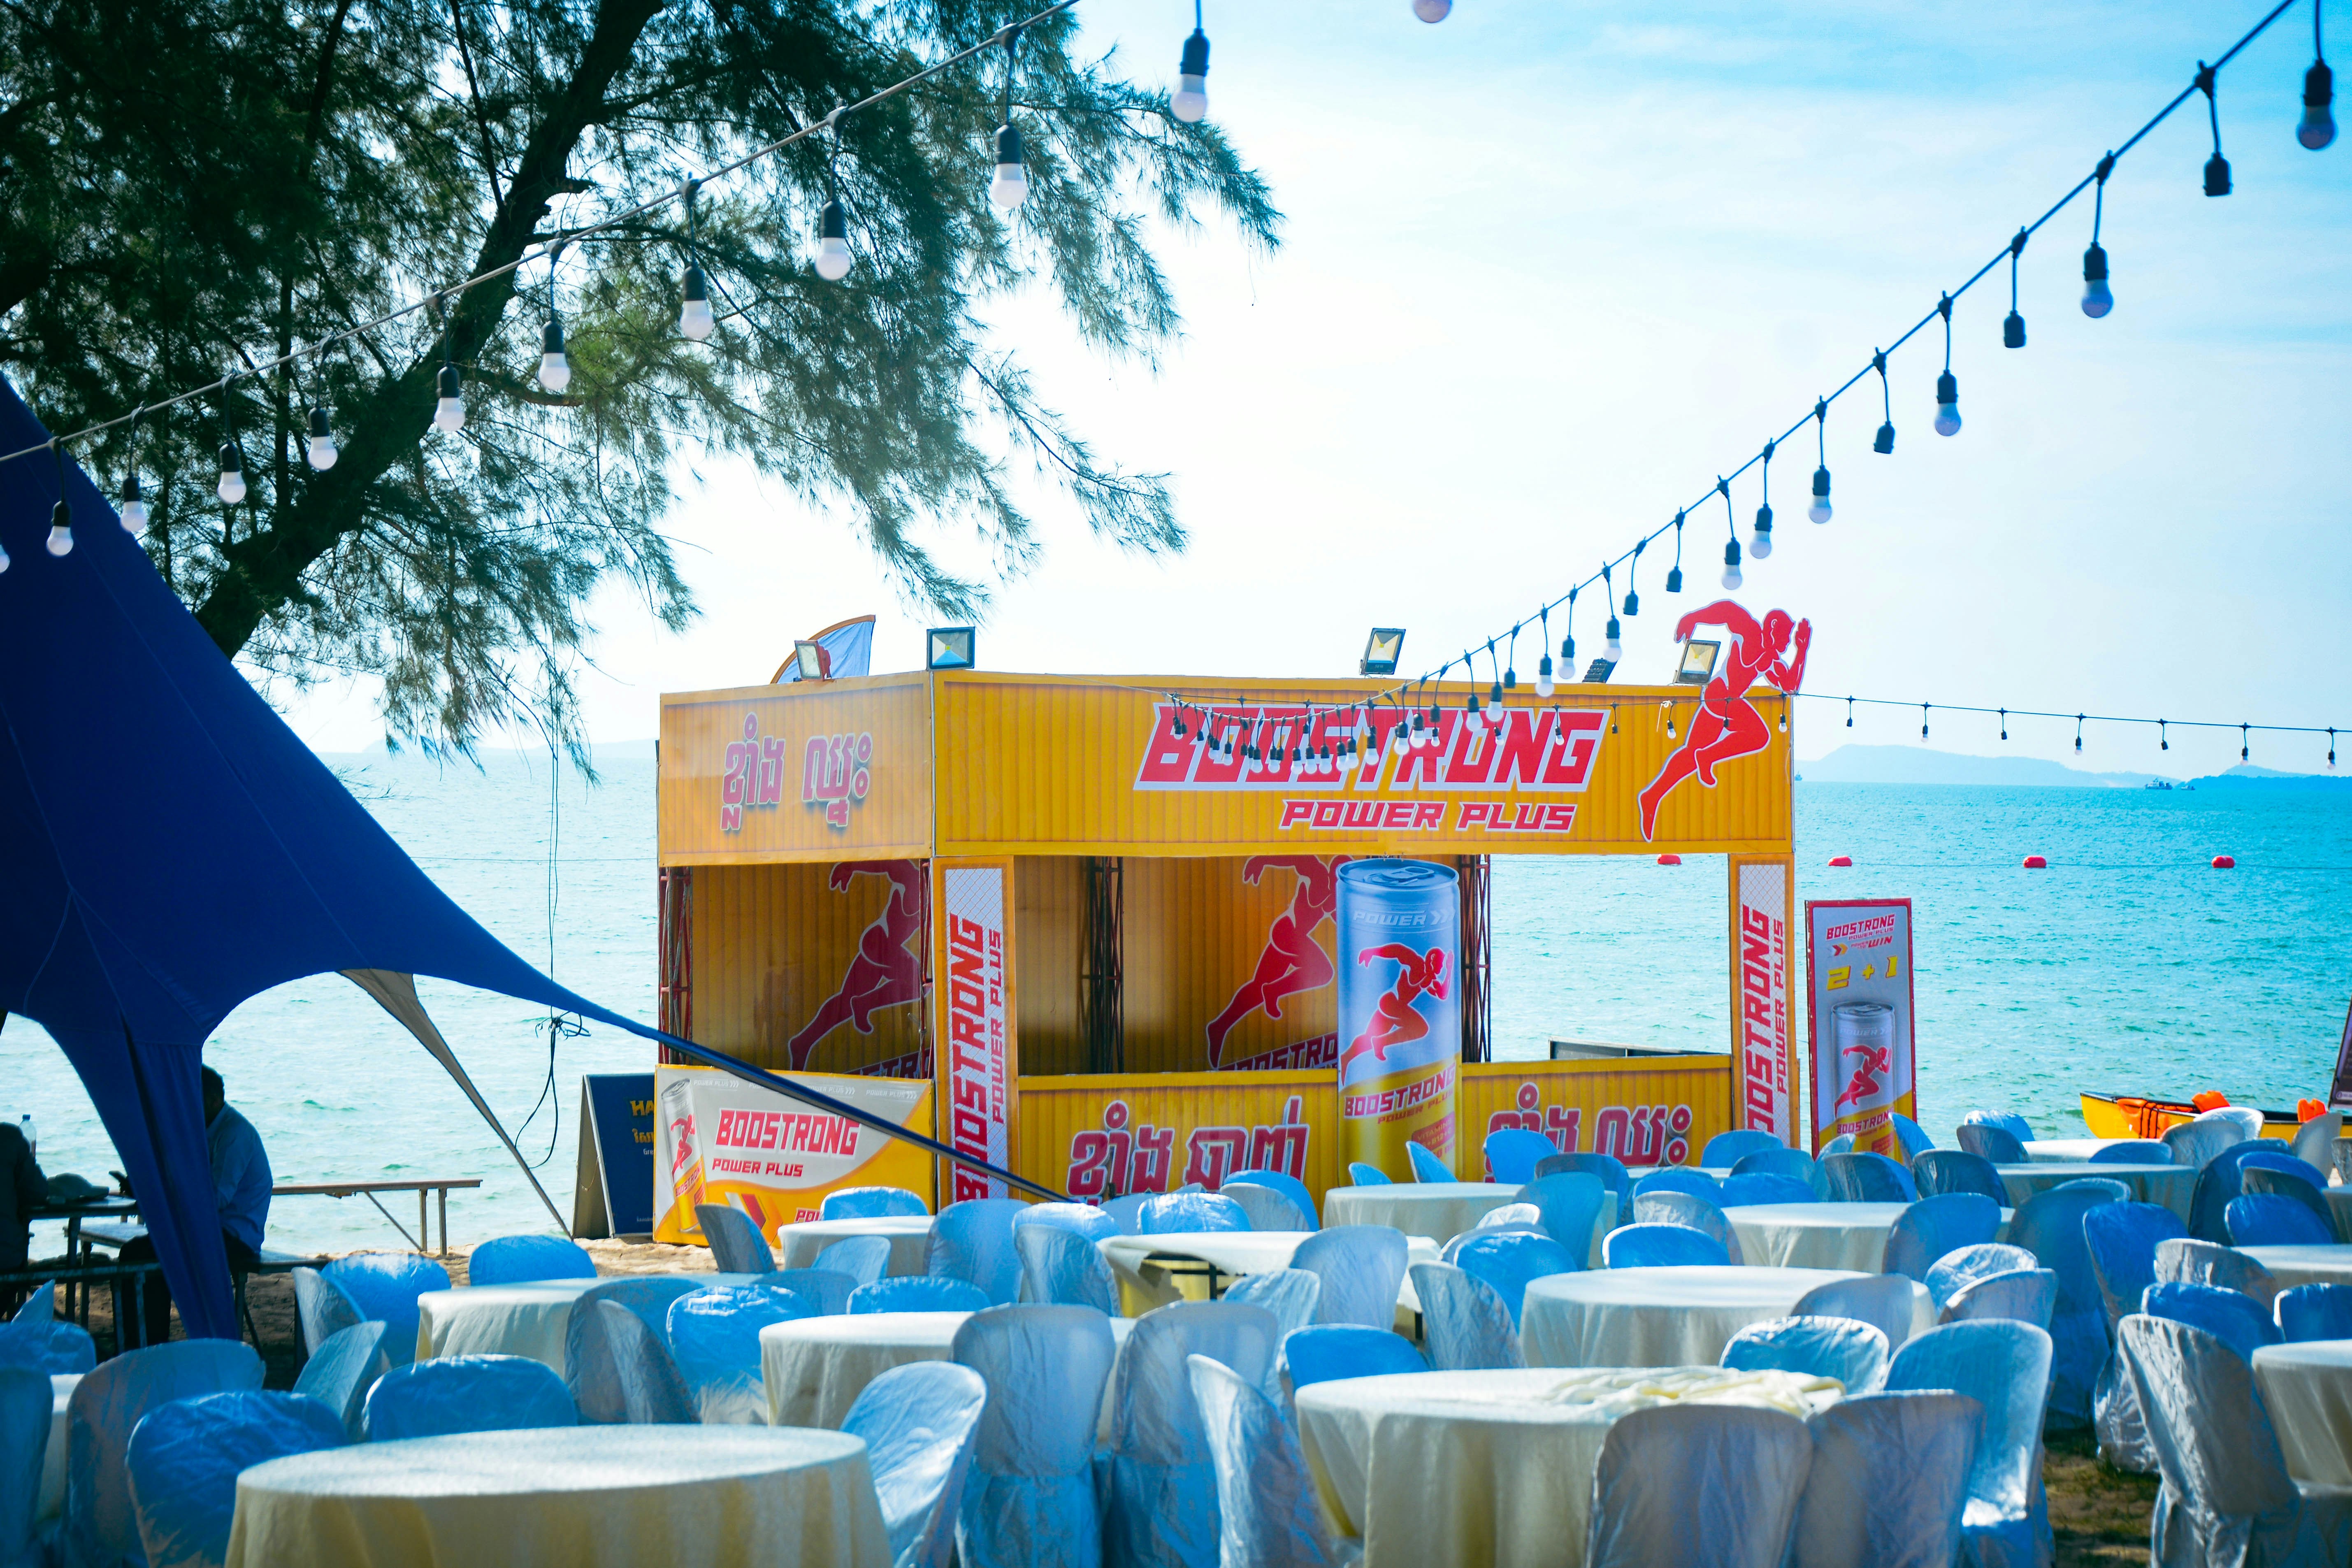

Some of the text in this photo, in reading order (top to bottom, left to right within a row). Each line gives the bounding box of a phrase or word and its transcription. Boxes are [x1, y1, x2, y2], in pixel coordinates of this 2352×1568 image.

[1133, 703, 1610, 792] BOOSTRONG
[1279, 799, 1578, 834] POWER PLUS
[1352, 908, 1428, 928] POWER
[1826, 913, 1895, 940] BOOSTRONG
[1848, 932, 1872, 940] POWER
[1868, 936, 1892, 948] WIN
[1827, 955, 1898, 991] 2 + 1
[1743, 903, 1774, 1134] OOSTRONG
[1774, 918, 1787, 1094] POWER PLUS
[989, 928, 1005, 1124] POWER PLUS
[1344, 1062, 1456, 1120] BOOSTRONG
[715, 1108, 861, 1158] BOOSTRONG
[1377, 1106, 1423, 1125] POWER
[712, 1158, 803, 1177] POWER PLUS
